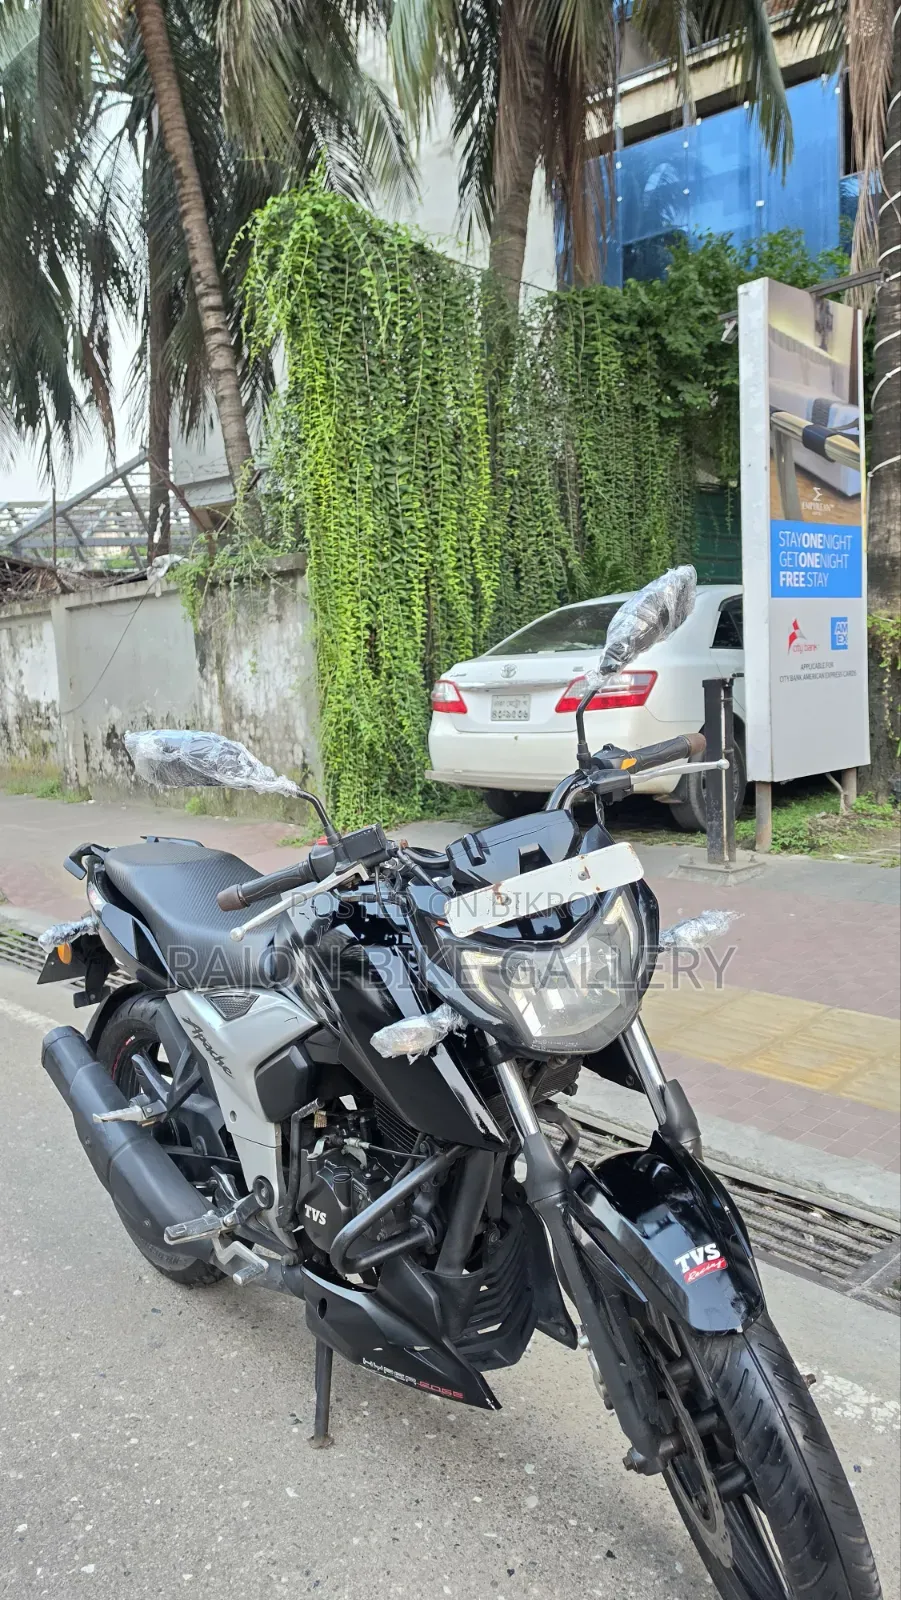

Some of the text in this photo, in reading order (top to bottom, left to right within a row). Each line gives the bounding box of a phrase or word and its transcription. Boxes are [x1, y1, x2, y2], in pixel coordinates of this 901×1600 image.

[779, 571, 829, 588] FREE STAY
[181, 1016, 235, 1079] Apache
[304, 1203, 327, 1225] TVS
[674, 1242, 721, 1274] TVS
